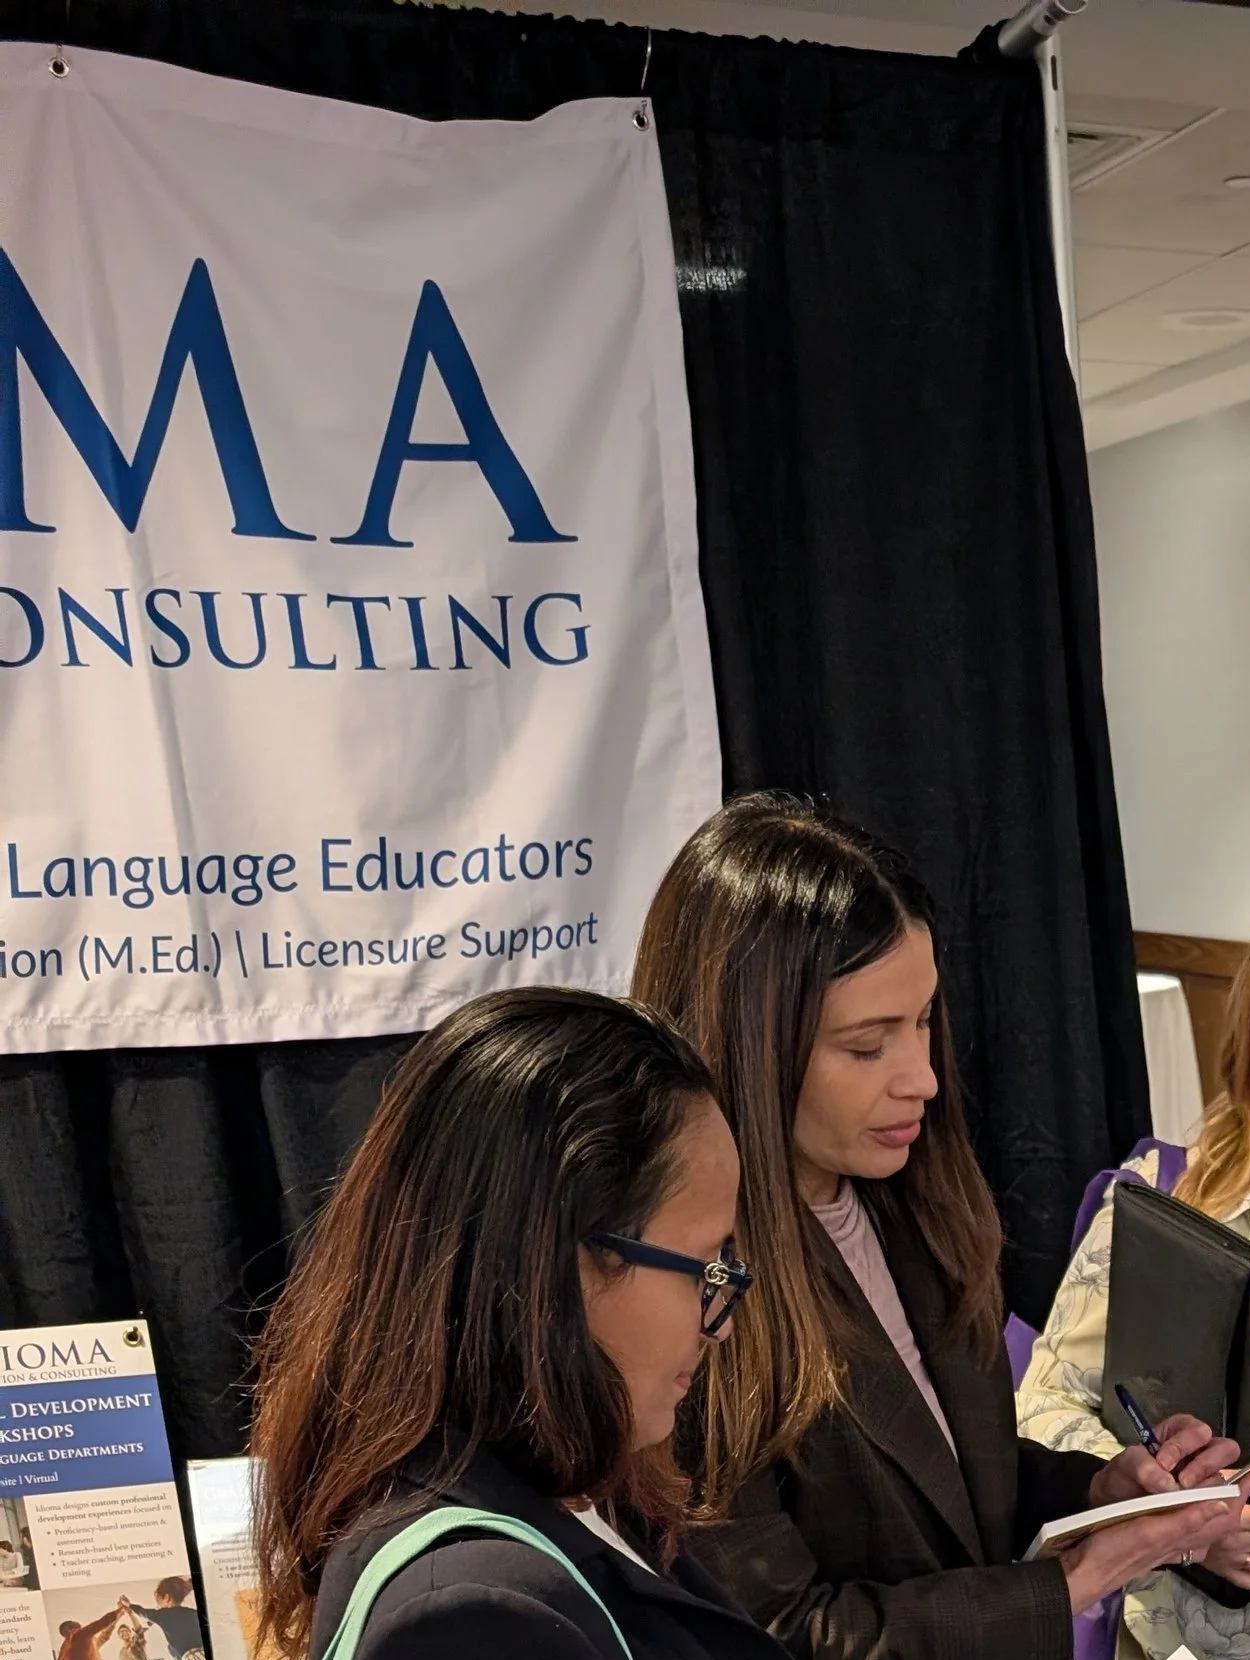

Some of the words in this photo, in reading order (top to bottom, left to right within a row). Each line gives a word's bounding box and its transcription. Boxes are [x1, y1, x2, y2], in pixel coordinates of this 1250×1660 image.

[8, 843, 298, 909] Language
[321, 834, 593, 891] Educators
[79, 928, 221, 987] (M.Ed.)
[262, 931, 447, 975] Licensure
[461, 912, 598, 961] Support
[28, 1373, 38, 1381] &
[40, 1366, 117, 1380] CONSULTING
[11, 1393, 152, 1418] DEVELOPMENT
[48, 1442, 144, 1460] DEPARTMENTS
[24, 1471, 59, 1484] Virtual
[35, 1504, 62, 1513] Idioma
[63, 1502, 90, 1511] designs
[120, 1492, 167, 1506] professional
[37, 1513, 86, 1523] development
[88, 1509, 132, 1520] experiences
[133, 1503, 161, 1514] focused
